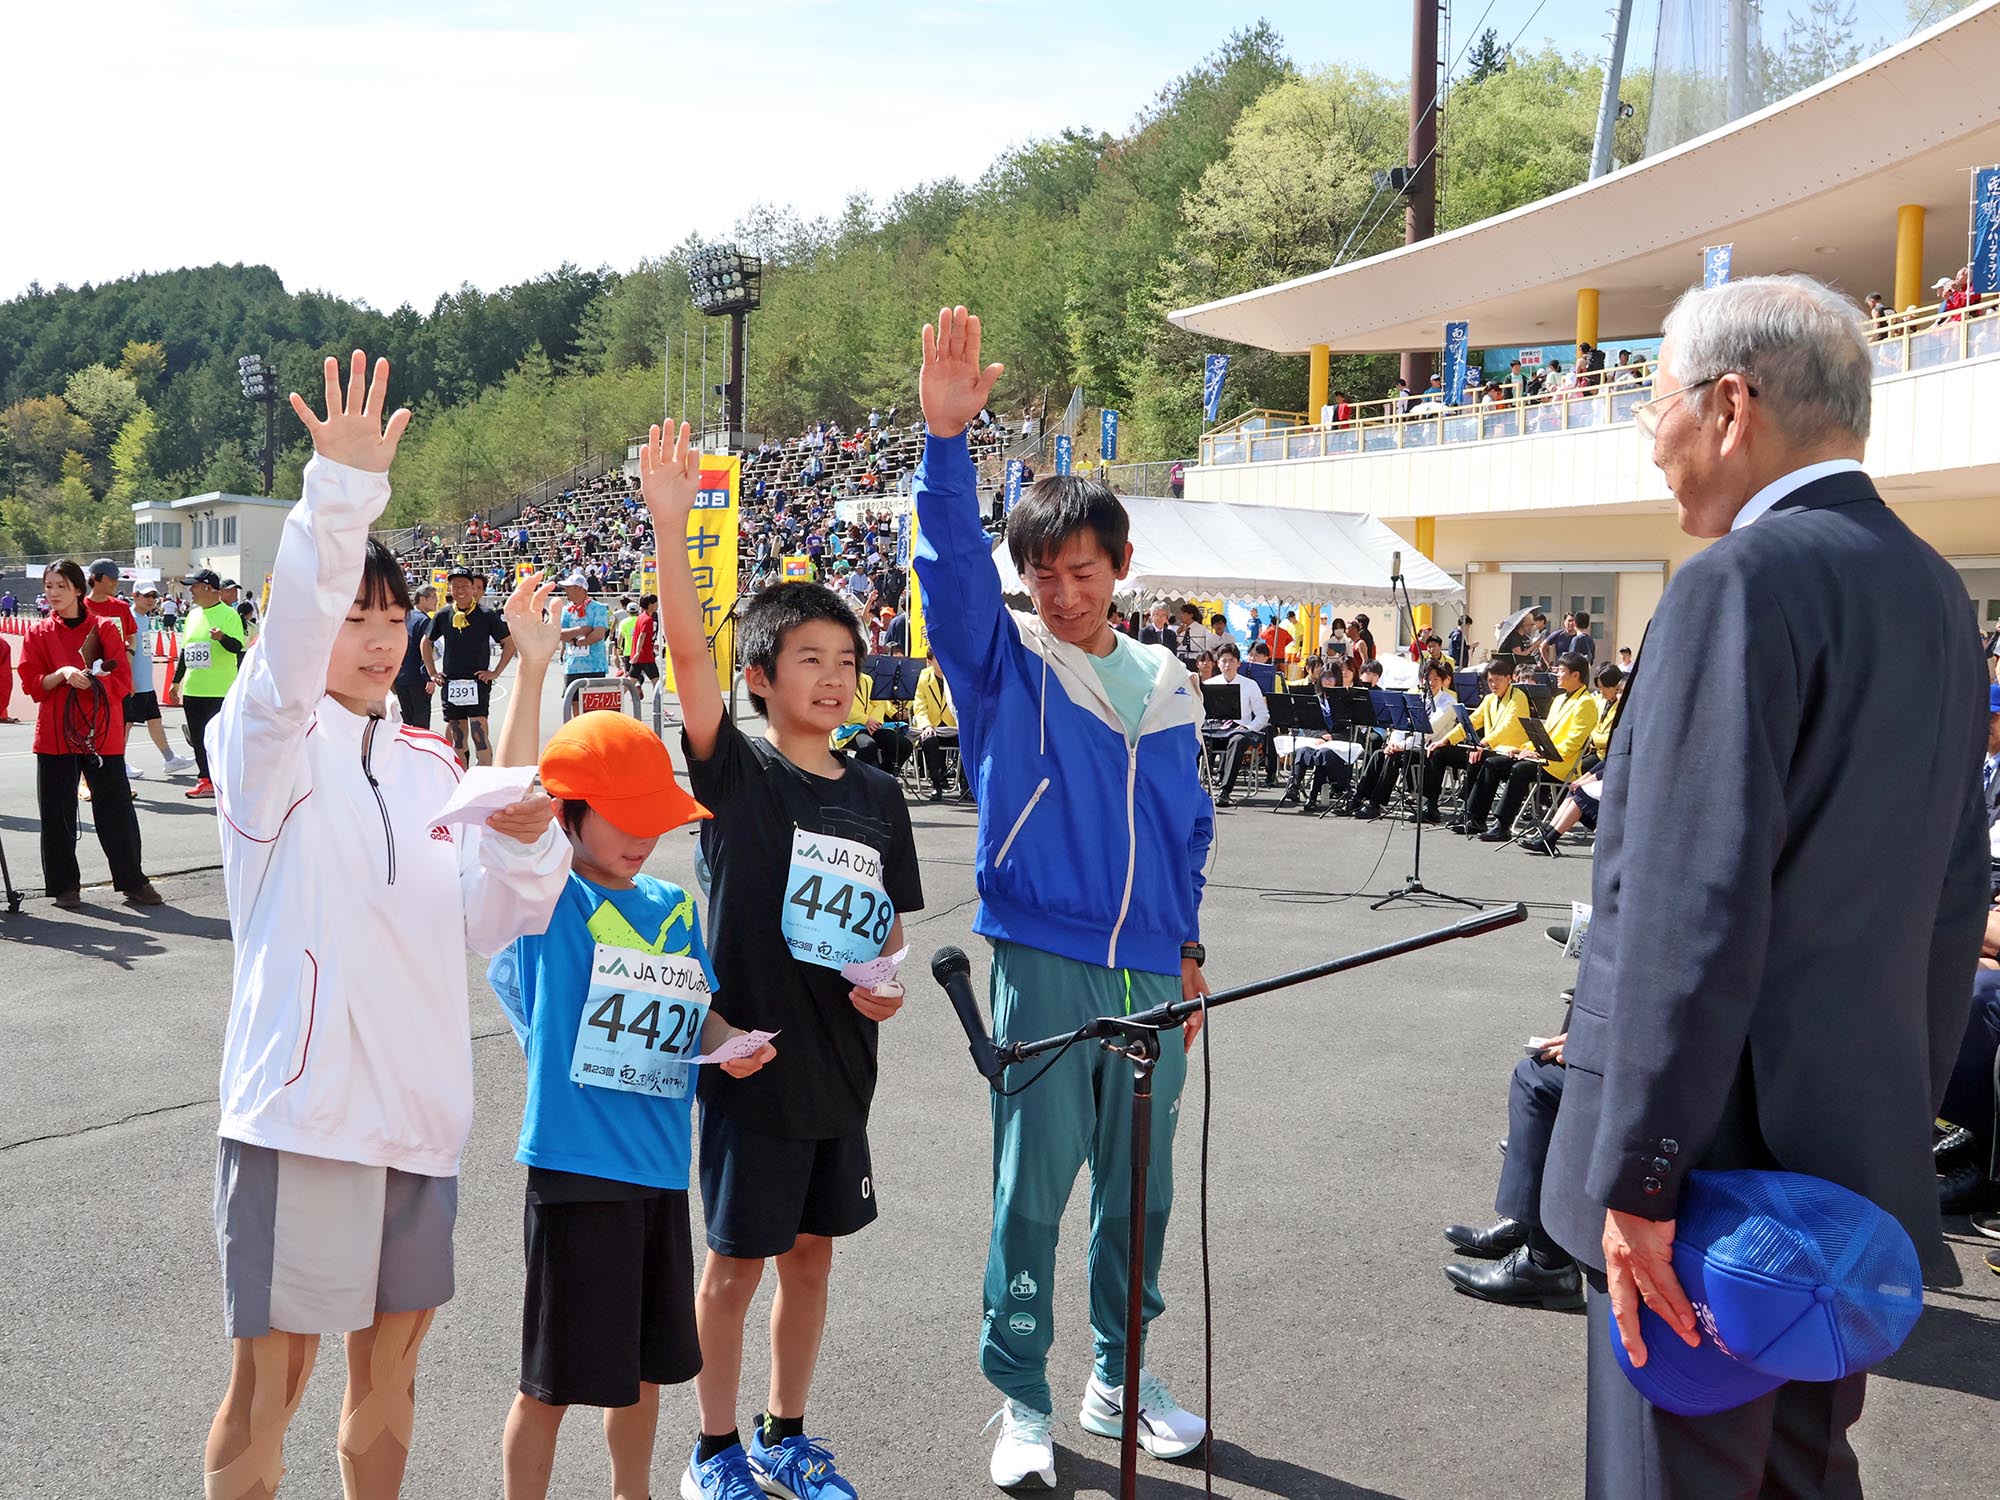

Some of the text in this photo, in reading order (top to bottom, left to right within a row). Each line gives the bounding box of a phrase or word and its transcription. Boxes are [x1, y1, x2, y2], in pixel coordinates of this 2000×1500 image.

[185, 650, 209, 662] 2389
[449, 687, 475, 698] 2391
[827, 848, 850, 868] JA
[790, 874, 892, 945] 4428
[633, 962, 657, 983] JA
[588, 993, 700, 1056] 4429
[582, 1062, 616, 1077] 第23回
